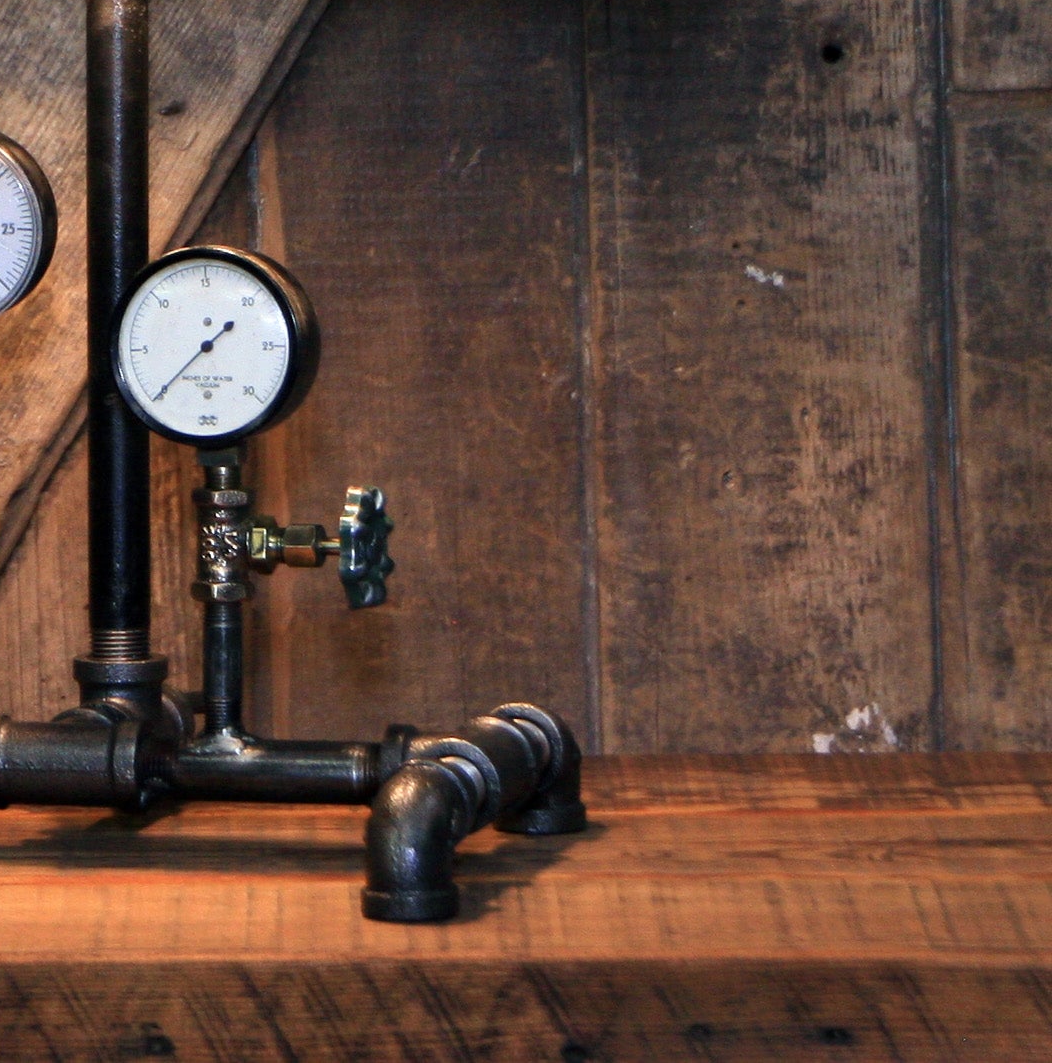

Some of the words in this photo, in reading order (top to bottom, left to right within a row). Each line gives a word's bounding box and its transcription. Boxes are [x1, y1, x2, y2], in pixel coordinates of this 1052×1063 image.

[1, 223, 15, 235] 25
[201, 279, 210, 288] 15
[159, 299, 169, 308] 10
[242, 297, 254, 306] 20
[143, 346, 149, 354] 5
[262, 341, 274, 351] 25
[243, 386, 255, 395] 30
